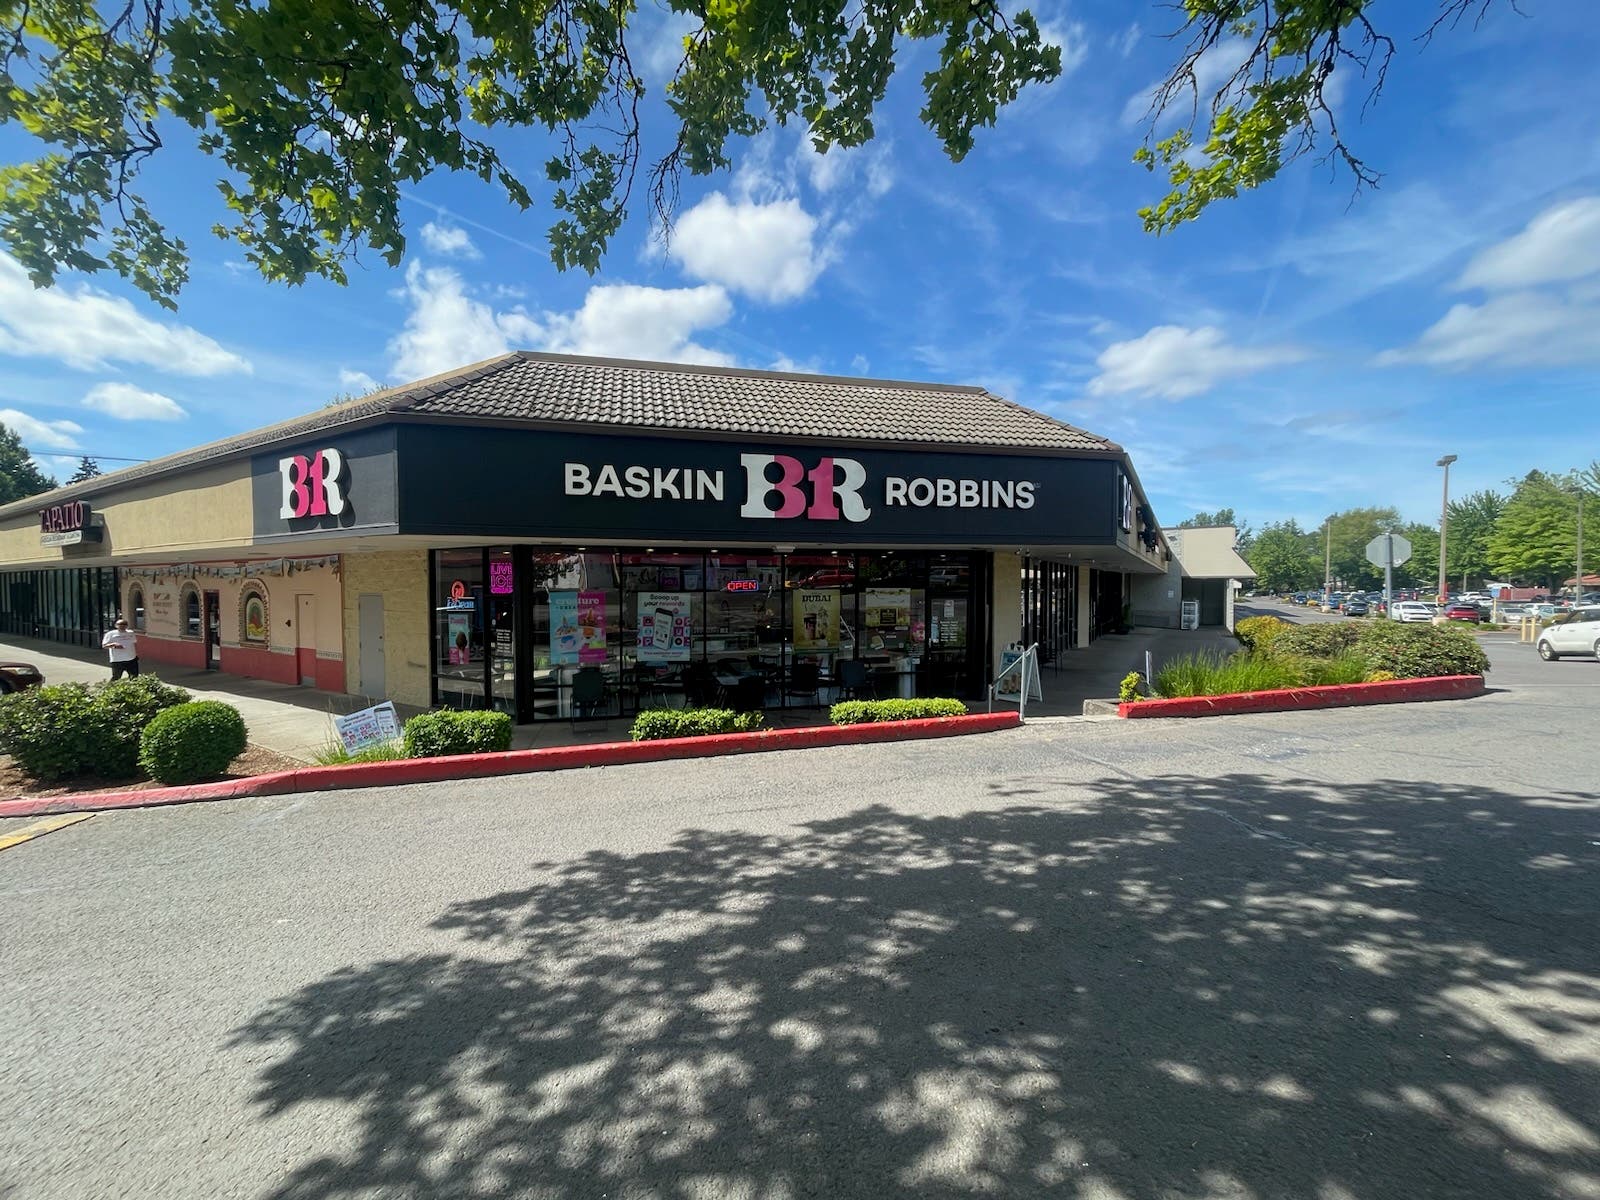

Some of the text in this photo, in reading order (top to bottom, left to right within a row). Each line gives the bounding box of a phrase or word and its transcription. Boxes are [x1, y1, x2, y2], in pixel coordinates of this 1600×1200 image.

[564, 462, 724, 501] BASKIN
[885, 476, 1035, 509] ROBBINS
[39, 501, 83, 532] TAPATIO
[727, 582, 757, 591] OPEN
[802, 594, 832, 602] DUBAI
